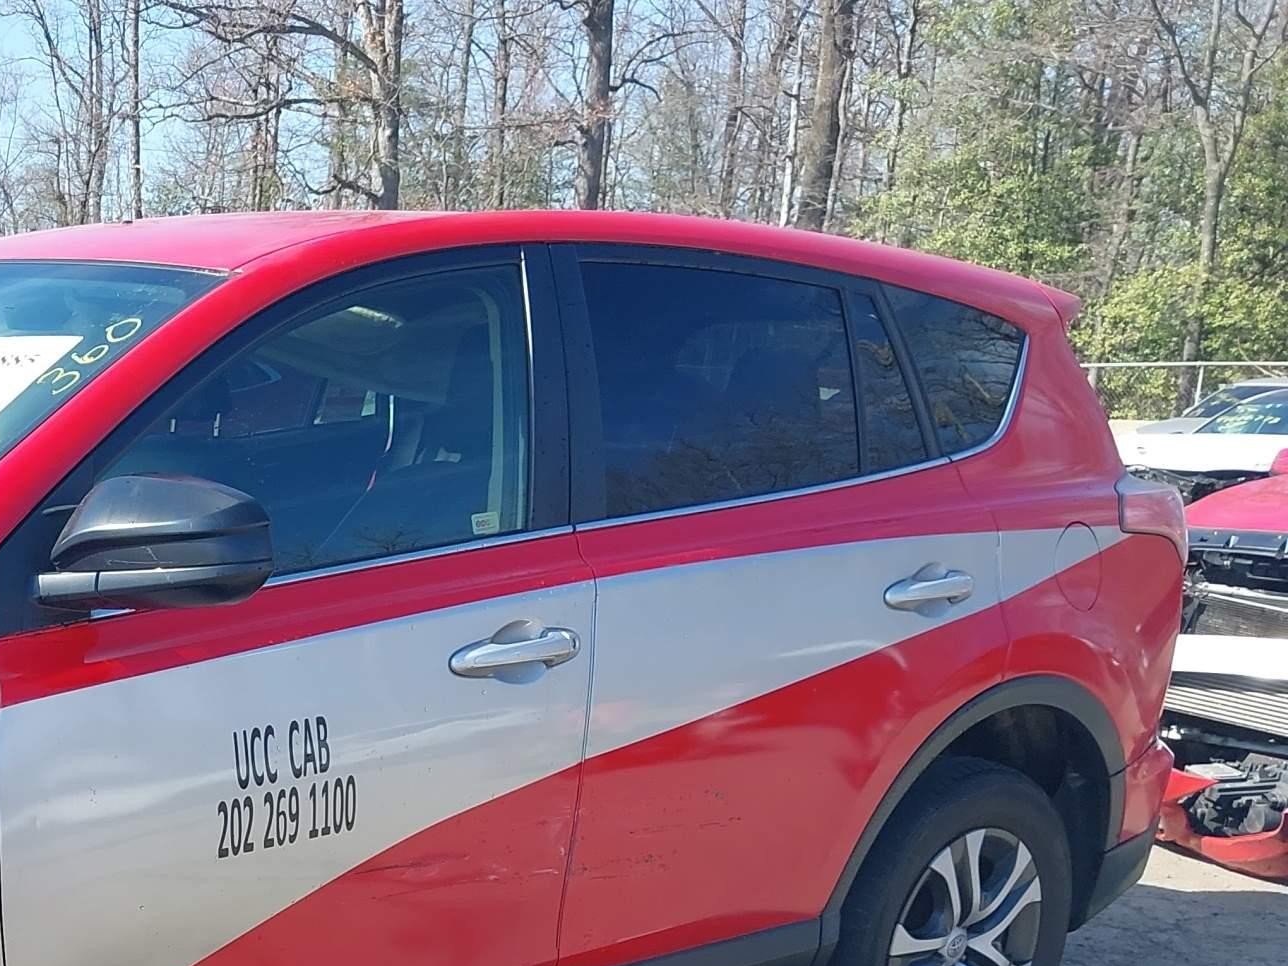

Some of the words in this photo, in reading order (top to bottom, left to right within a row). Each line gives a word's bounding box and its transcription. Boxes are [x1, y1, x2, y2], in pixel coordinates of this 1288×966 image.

[36, 318, 142, 395] 360
[232, 724, 278, 790] UCC
[288, 715, 331, 779] CAB
[217, 796, 255, 859] 202
[263, 787, 300, 849] 269
[309, 775, 357, 839] 1100
